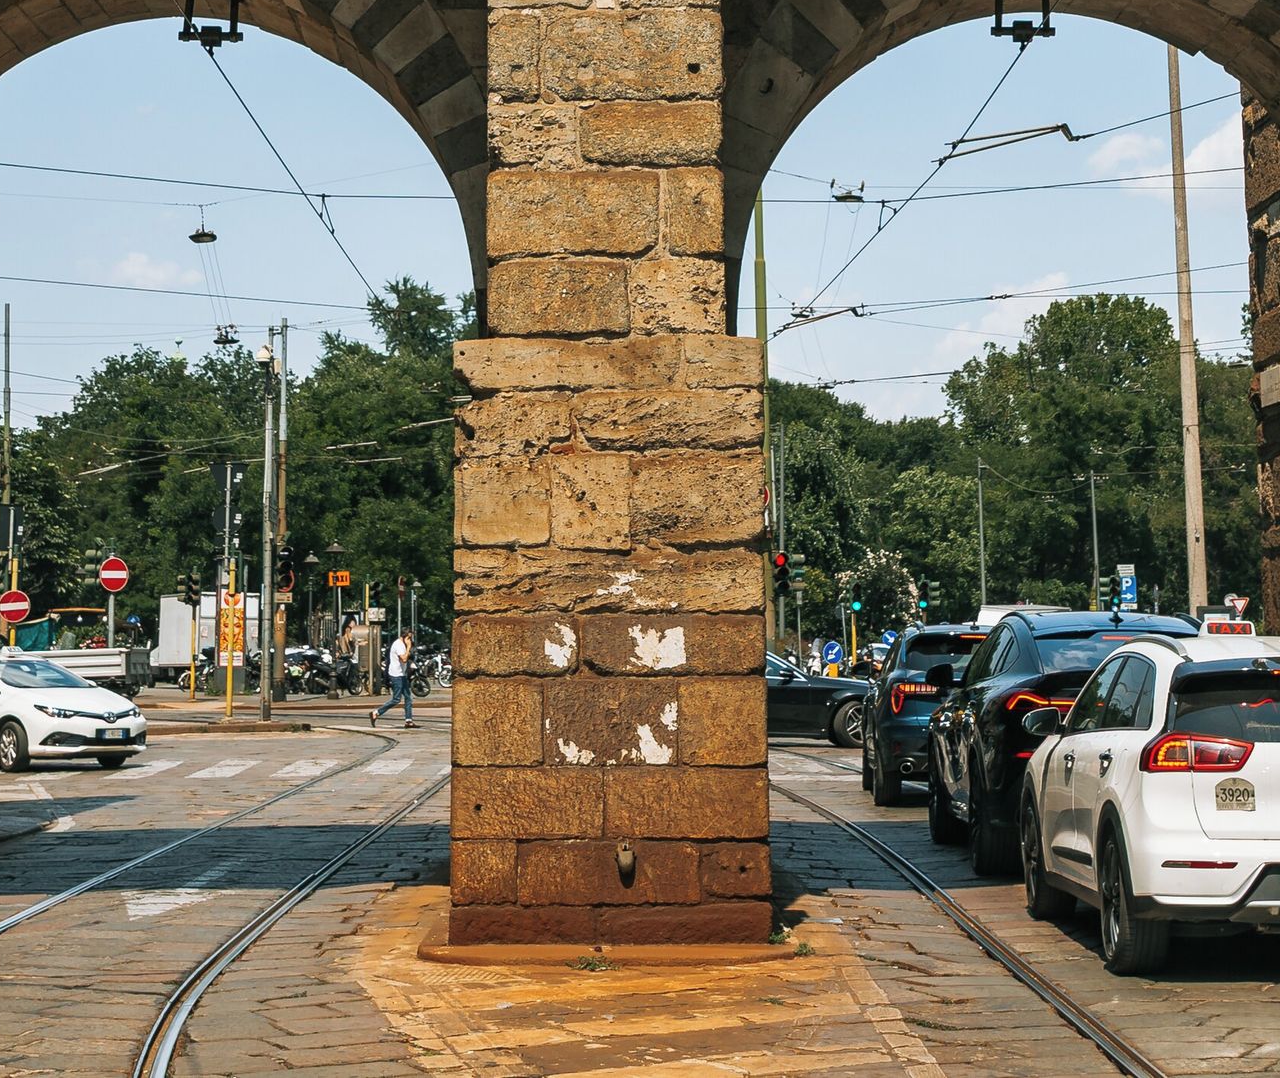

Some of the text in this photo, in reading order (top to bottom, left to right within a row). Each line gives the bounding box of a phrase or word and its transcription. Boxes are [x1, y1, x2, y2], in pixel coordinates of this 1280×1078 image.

[1122, 577, 1133, 591] P
[1208, 623, 1251, 634] TAXI
[1219, 787, 1250, 803] 3920
